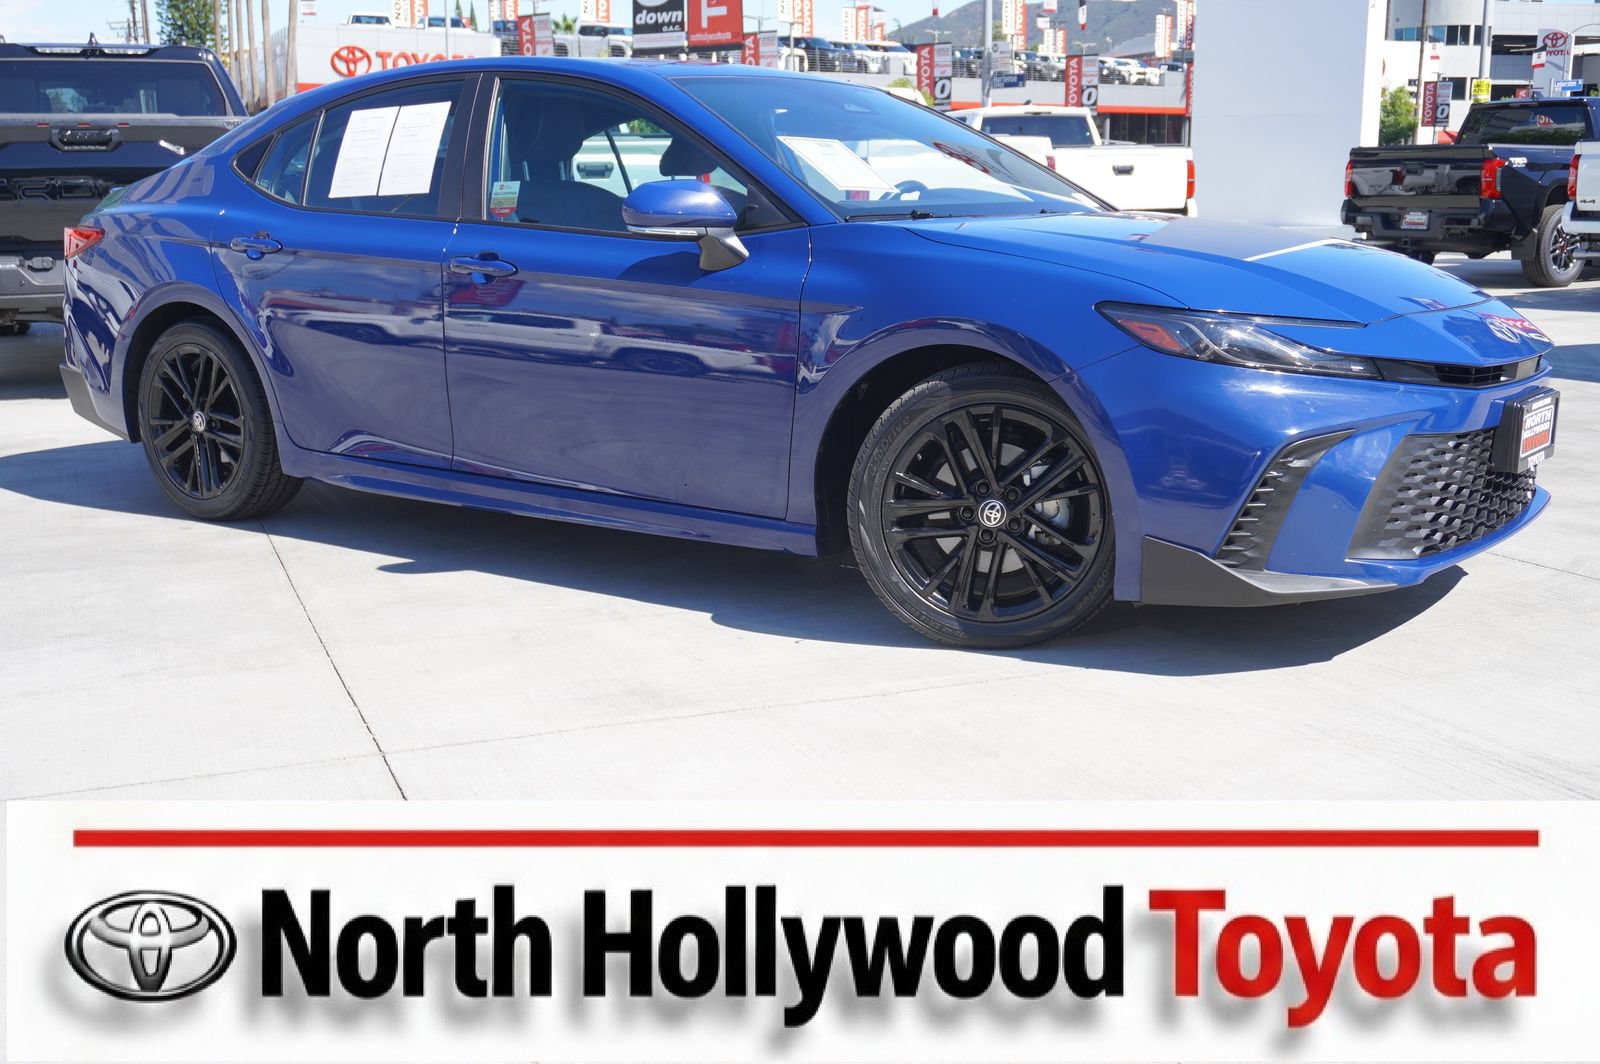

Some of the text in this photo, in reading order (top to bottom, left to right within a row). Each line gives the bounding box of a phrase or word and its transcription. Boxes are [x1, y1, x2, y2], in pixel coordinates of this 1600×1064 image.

[635, 9, 683, 25] down
[1069, 58, 1078, 106] OYOTA
[1424, 83, 1435, 123] TOYOTA
[1525, 409, 1552, 430] NORTH
